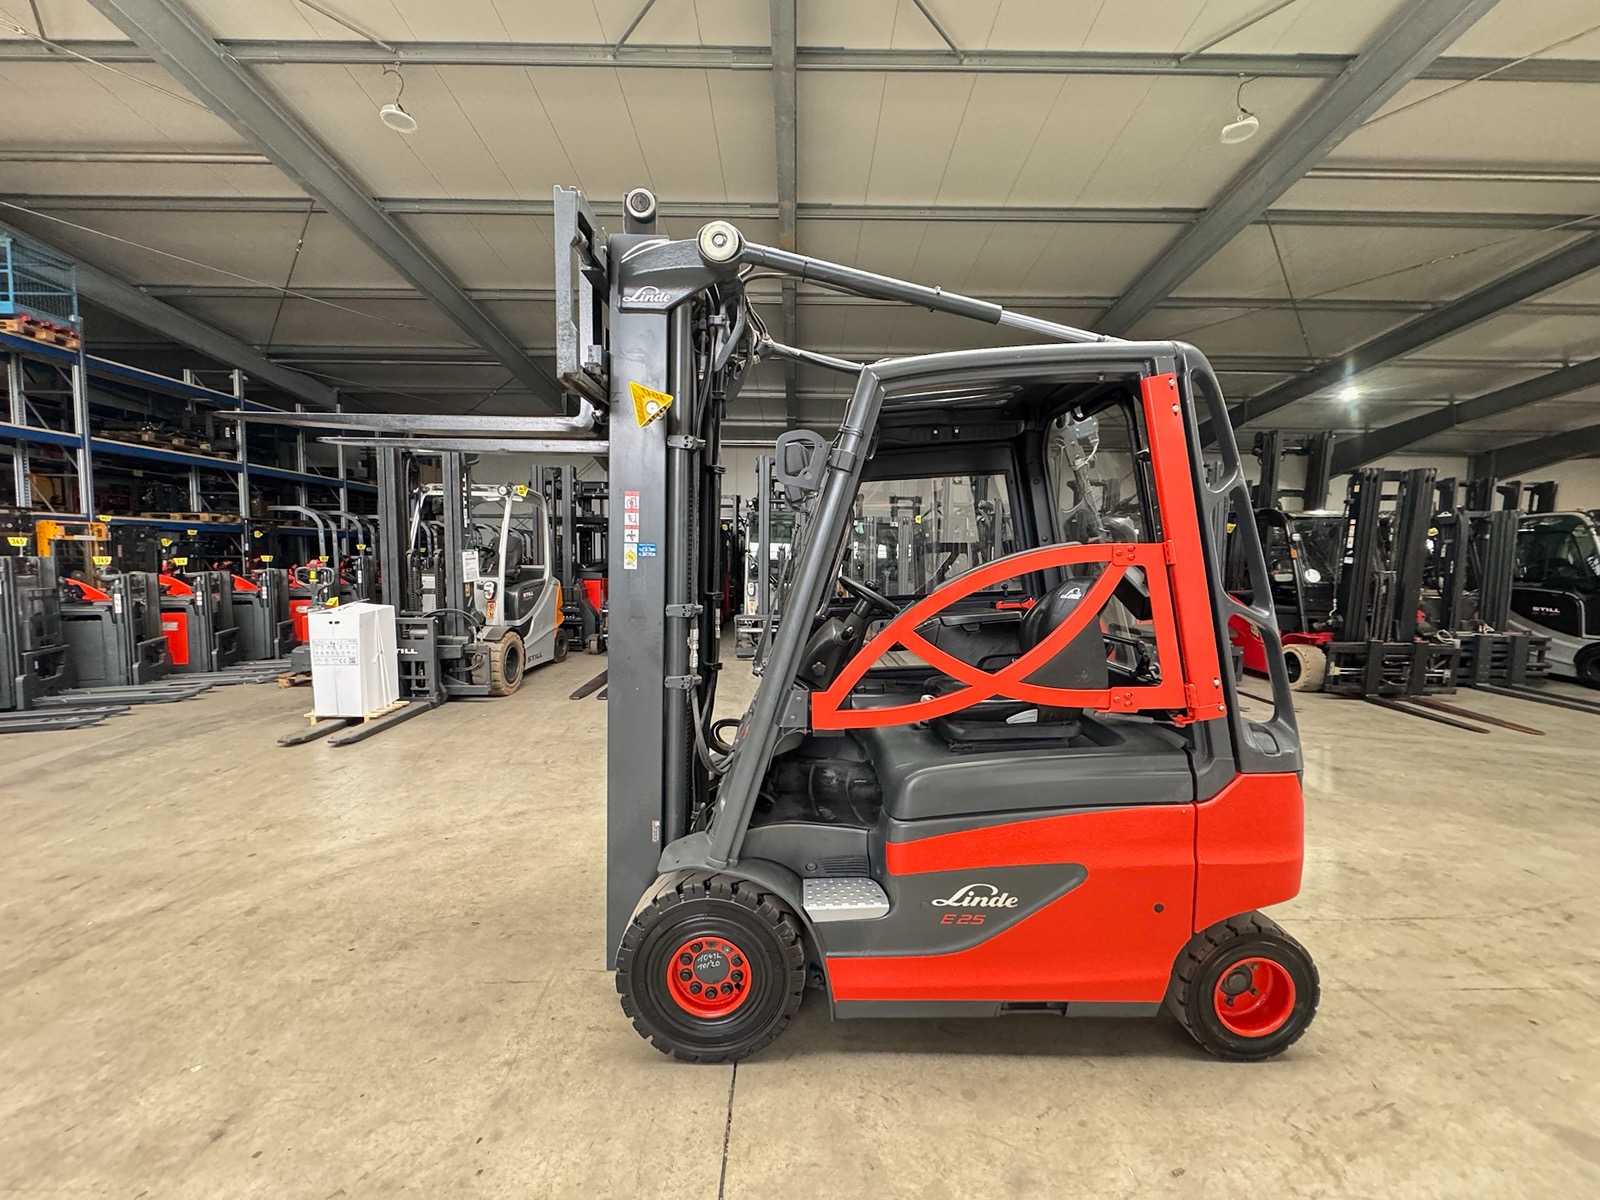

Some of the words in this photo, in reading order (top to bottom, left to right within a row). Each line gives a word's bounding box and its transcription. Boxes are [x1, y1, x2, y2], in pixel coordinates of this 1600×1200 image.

[622, 286, 672, 303] Linde
[528, 651, 543, 663] STILL
[931, 883, 1018, 909] Linde
